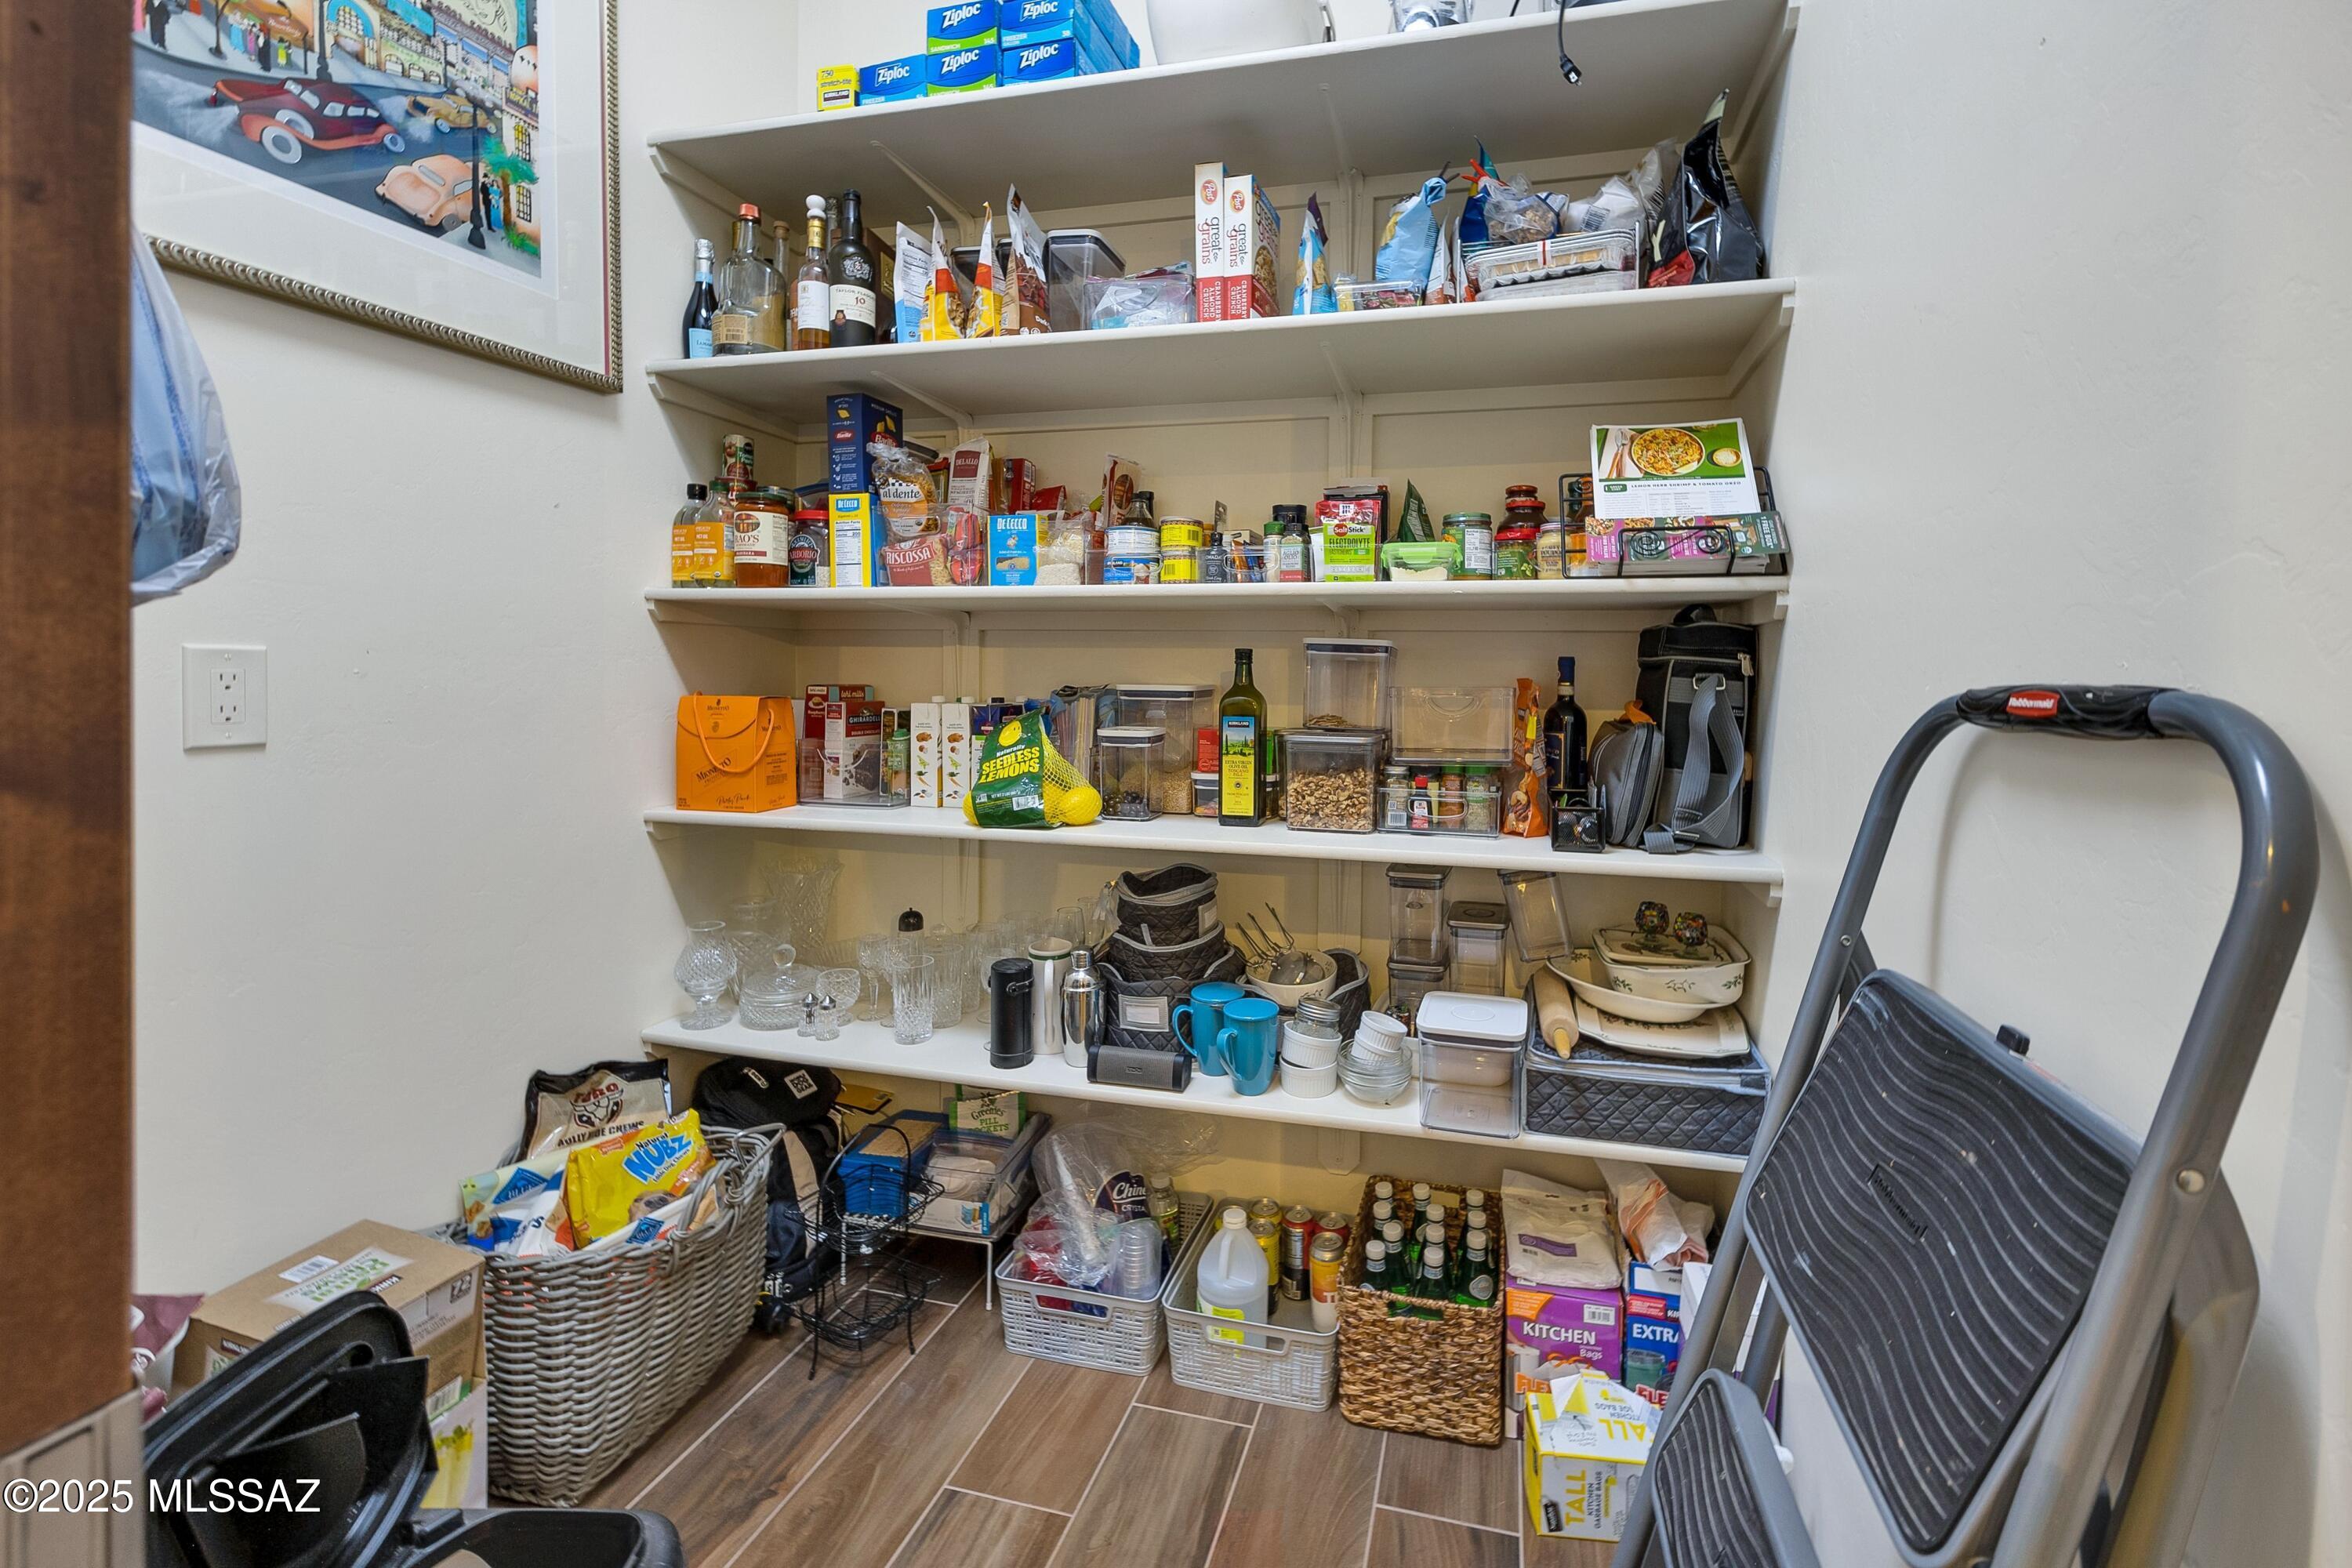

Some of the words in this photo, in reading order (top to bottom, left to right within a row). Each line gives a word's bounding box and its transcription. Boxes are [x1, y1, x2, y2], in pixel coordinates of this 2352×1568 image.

[942, 3, 981, 28] Ziploc
[1023, 1, 1058, 19] Ziploc
[931, 44, 960, 53] SANDWICH
[1019, 44, 1058, 68] Ziploc
[941, 49, 979, 74] Ziploc
[877, 66, 909, 85] Ziploc
[1203, 181, 1214, 201] Post
[1232, 192, 1243, 210] Post
[1197, 218, 1211, 264] grains
[1210, 216, 1223, 254] great
[1237, 223, 1248, 258] great
[1225, 225, 1239, 267] grains
[855, 296, 866, 305] 10
[883, 488, 891, 499] al
[892, 488, 920, 499] dente
[735, 534, 759, 543] RAO'S
[1329, 538, 1370, 548] ELECTROLYTE
[789, 550, 818, 559] ARBORIO
[886, 547, 931, 564] RISCOSSA
[2009, 697, 2055, 710] Rubbermaid
[982, 746, 1040, 775] SEEDLESS
[996, 744, 1025, 757] Naturally
[978, 758, 1040, 783] LEMONS
[979, 1117, 999, 1126] PILL
[636, 1131, 669, 1151] Natural
[622, 1134, 693, 1182] NUBZ
[1523, 1322, 1596, 1345] KITCHEN
[1579, 1348, 1603, 1360] Bags
[1515, 1372, 1551, 1393] FLE
[1635, 1384, 1670, 1408] FLE
[1598, 1418, 1646, 1441] ALL
[1565, 1468, 1586, 1526] TALL
